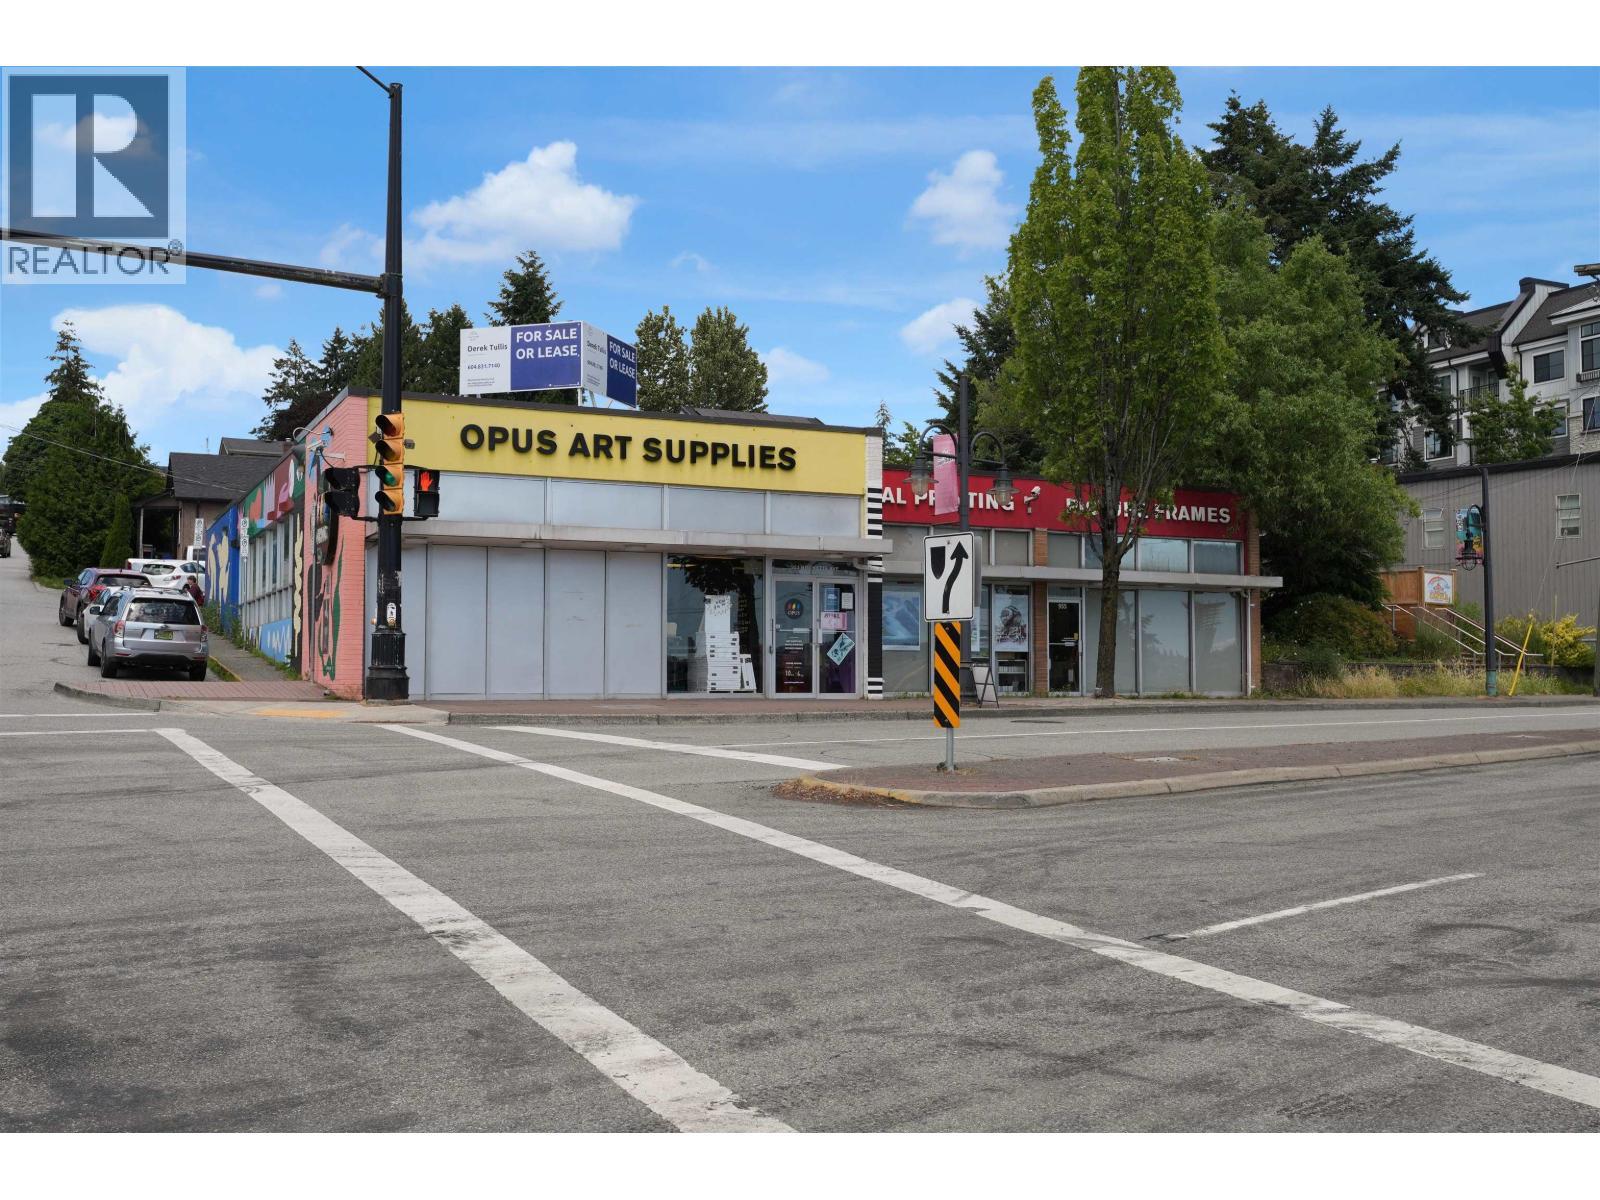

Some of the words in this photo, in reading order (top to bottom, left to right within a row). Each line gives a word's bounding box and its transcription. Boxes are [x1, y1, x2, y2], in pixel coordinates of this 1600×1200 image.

[516, 330, 542, 343] FOR
[545, 328, 578, 341] SALE
[467, 344, 488, 353] Derek
[490, 343, 508, 352] Tullis
[516, 348, 535, 360] OR
[538, 345, 578, 358] LEASE
[609, 341, 621, 356] FOR
[621, 347, 636, 363] SALE
[609, 357, 619, 371] OR
[618, 361, 636, 379] LEASE
[460, 423, 558, 456] OPUS
[568, 432, 633, 460] ART
[642, 437, 797, 471] SUPPLIES
[914, 488, 1015, 511] PRTING
